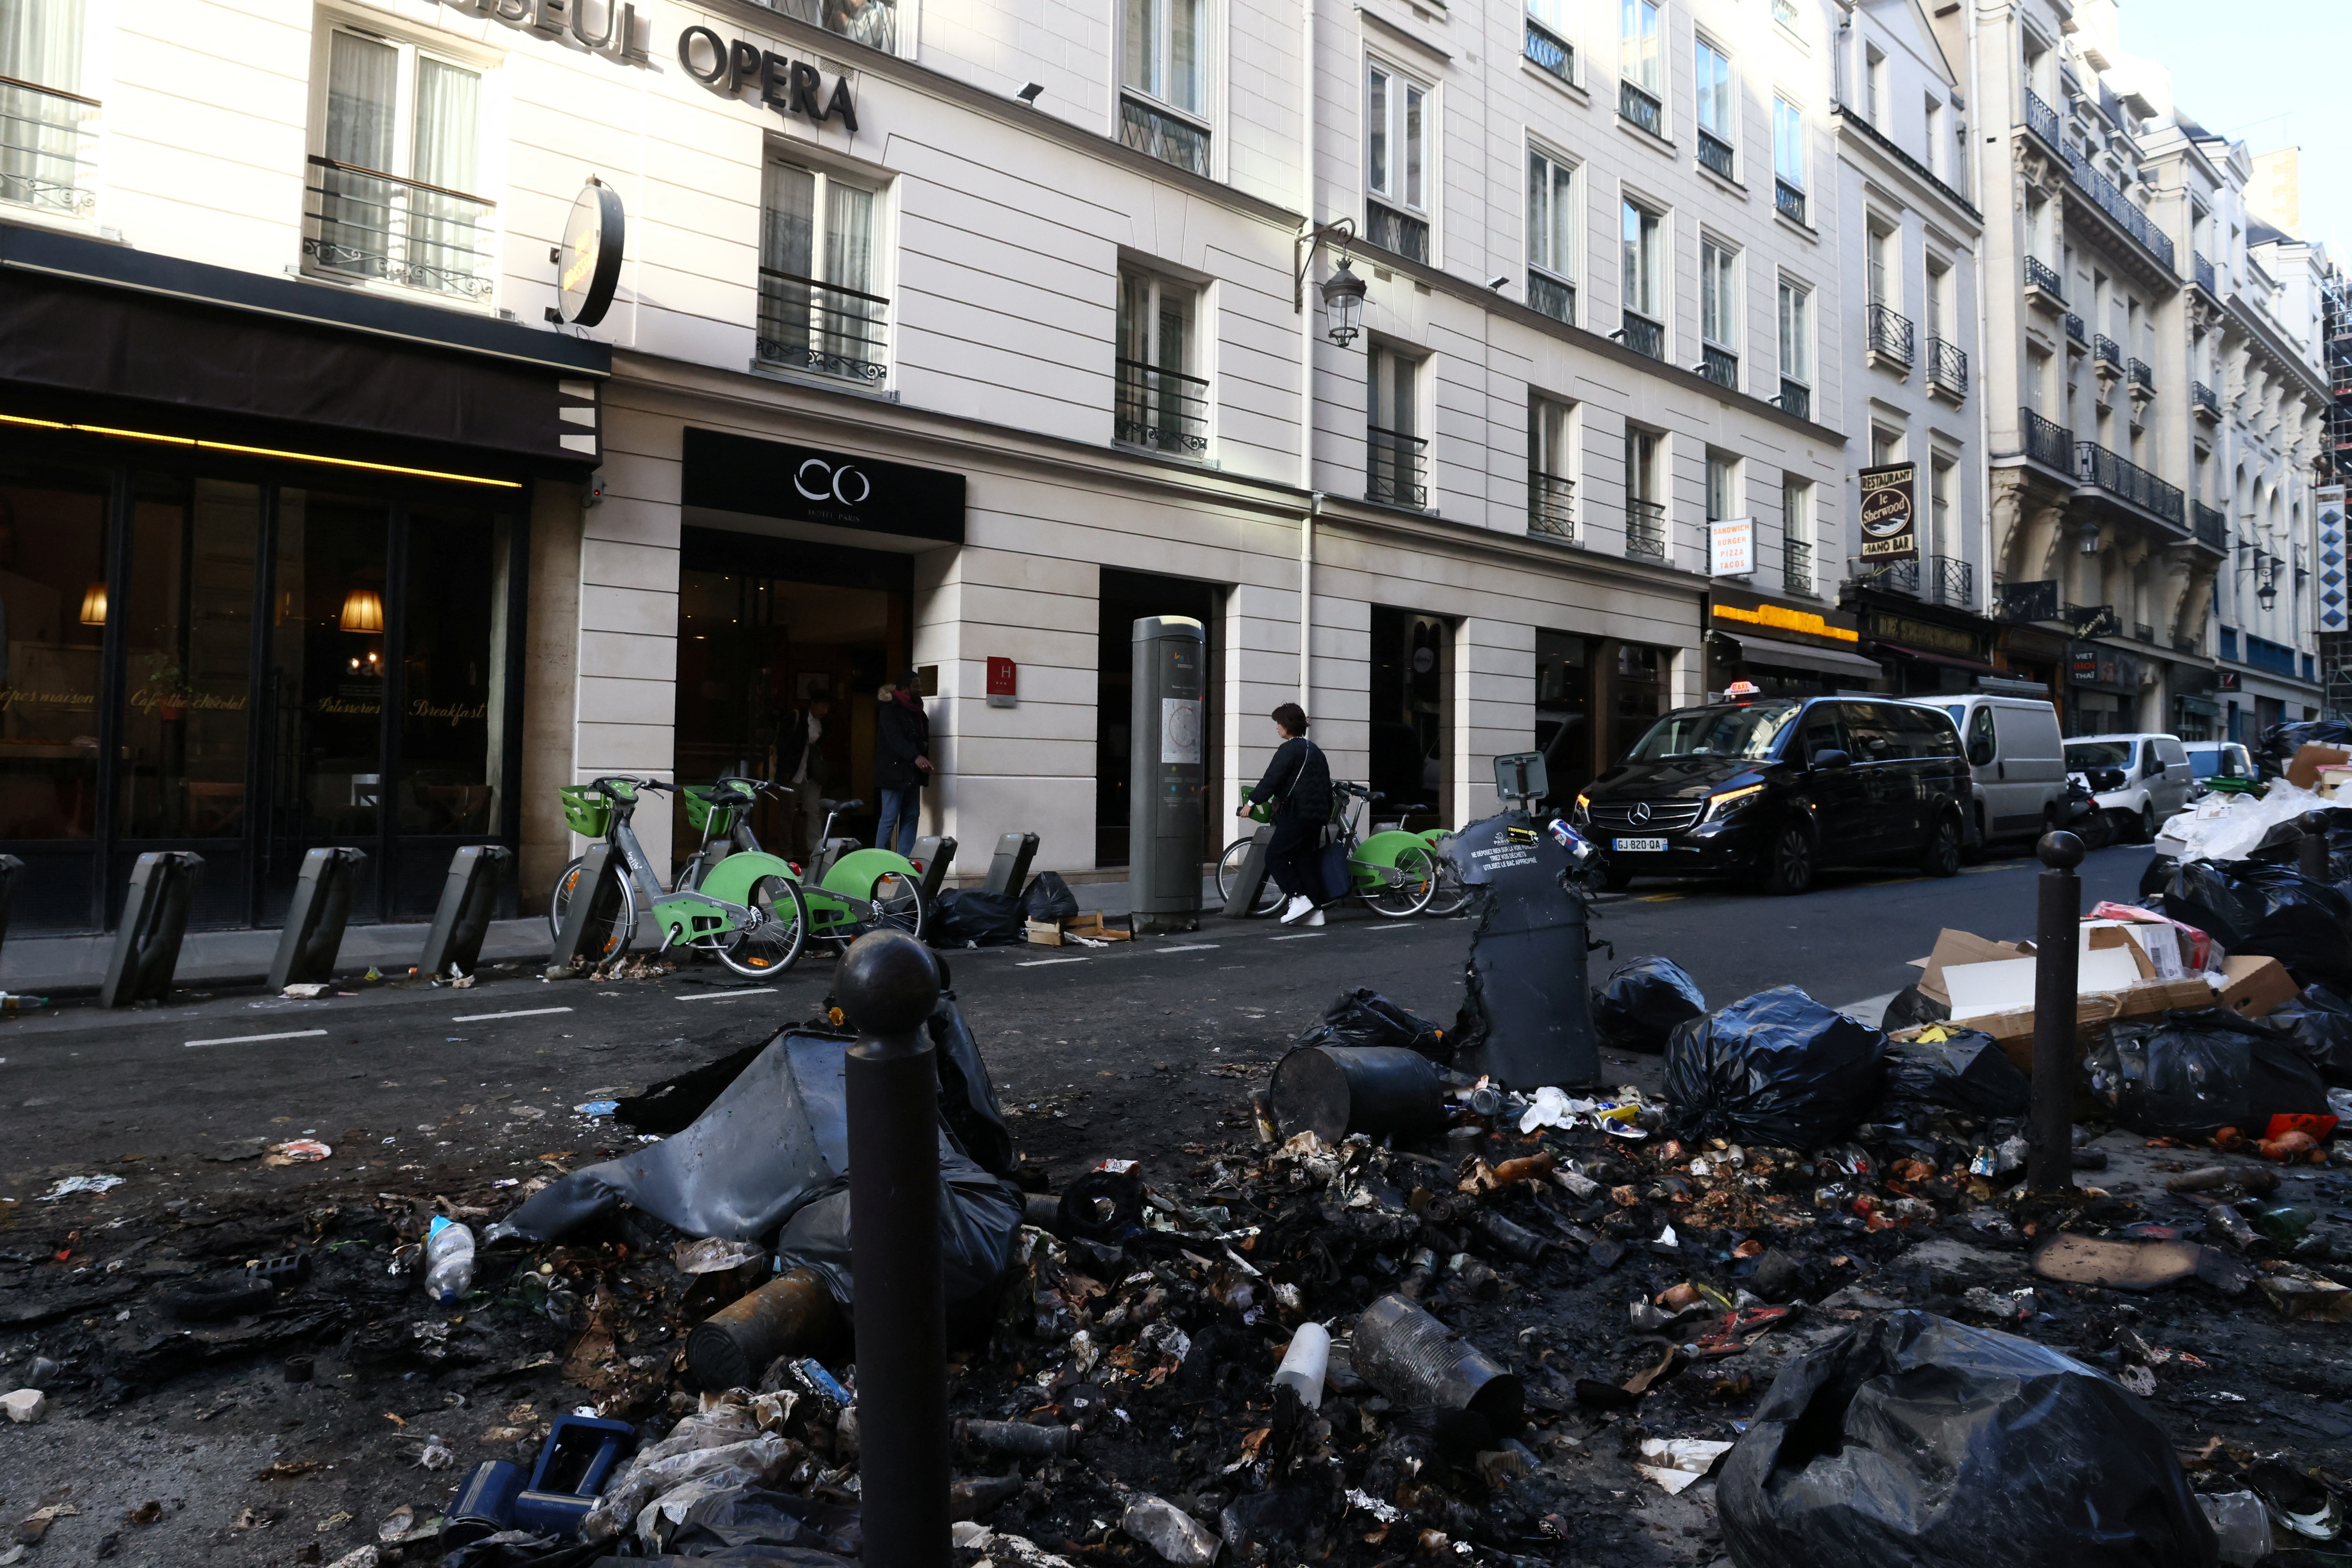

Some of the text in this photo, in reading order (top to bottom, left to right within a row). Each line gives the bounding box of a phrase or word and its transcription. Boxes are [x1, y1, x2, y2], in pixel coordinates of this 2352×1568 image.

[677, 25, 859, 133] OPERA
[1862, 470, 1911, 490] RESTAURANT
[1879, 493, 1888, 505] le
[808, 509, 860, 522] HOTEL PARIS
[1863, 497, 1905, 524] Sherwood
[1713, 524, 1750, 535] SANDWICH
[1717, 536, 1746, 546] BURGER
[1864, 536, 1910, 555] PIANO BAR
[1720, 548, 1744, 557] PIZZA
[1720, 560, 1745, 569] TACOS
[1001, 666, 1011, 678] H
[39, 688, 95, 704] maison
[193, 694, 247, 710] chocolat
[409, 699, 487, 727] Breakfast
[1618, 840, 1661, 849] GJ-820-QA
[1516, 856, 1538, 865] APPROPRIÉ
